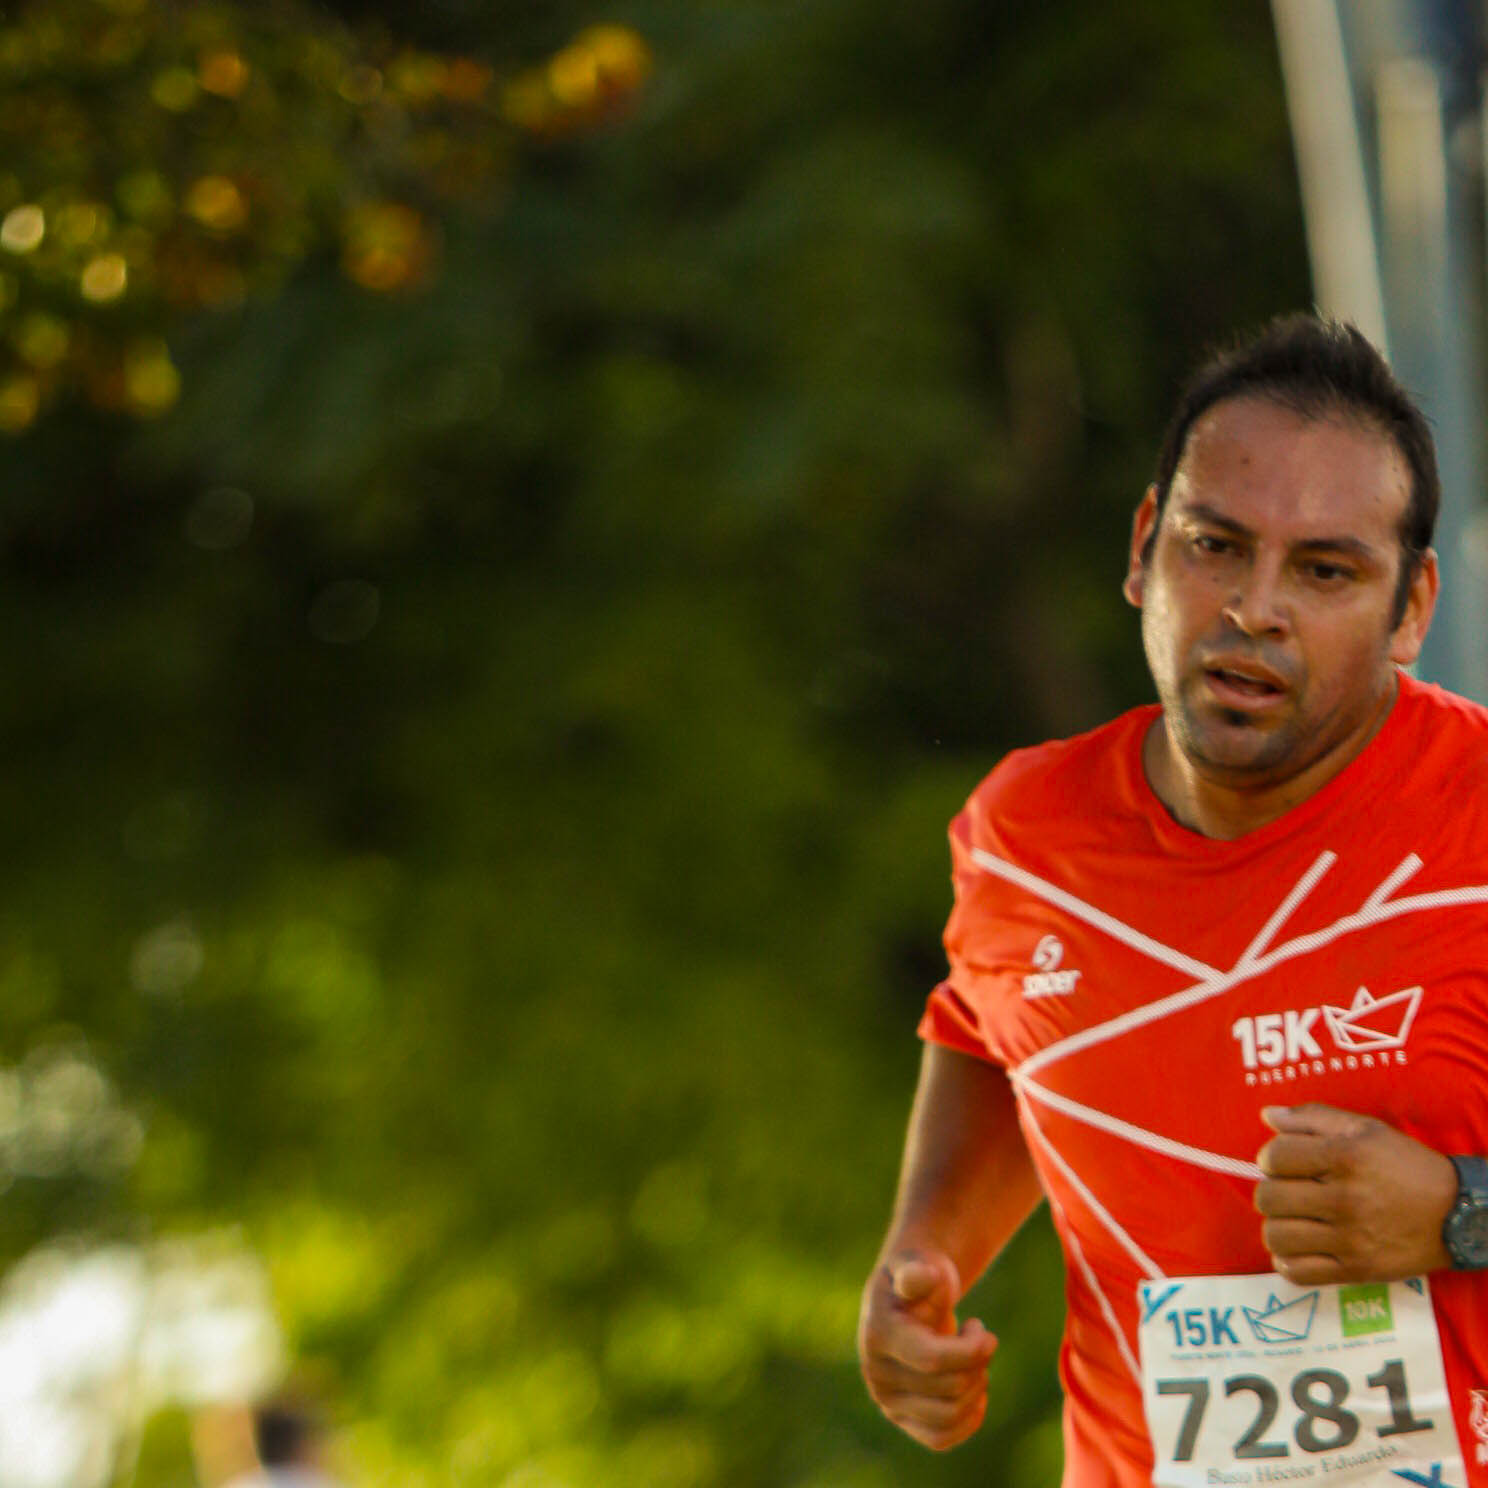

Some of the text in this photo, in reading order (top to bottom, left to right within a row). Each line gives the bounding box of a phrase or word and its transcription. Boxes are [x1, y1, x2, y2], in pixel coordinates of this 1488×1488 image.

[1232, 1008, 1323, 1069] 15K
[1166, 1307, 1240, 1348] 15K
[1156, 1358, 1434, 1462] 7281
